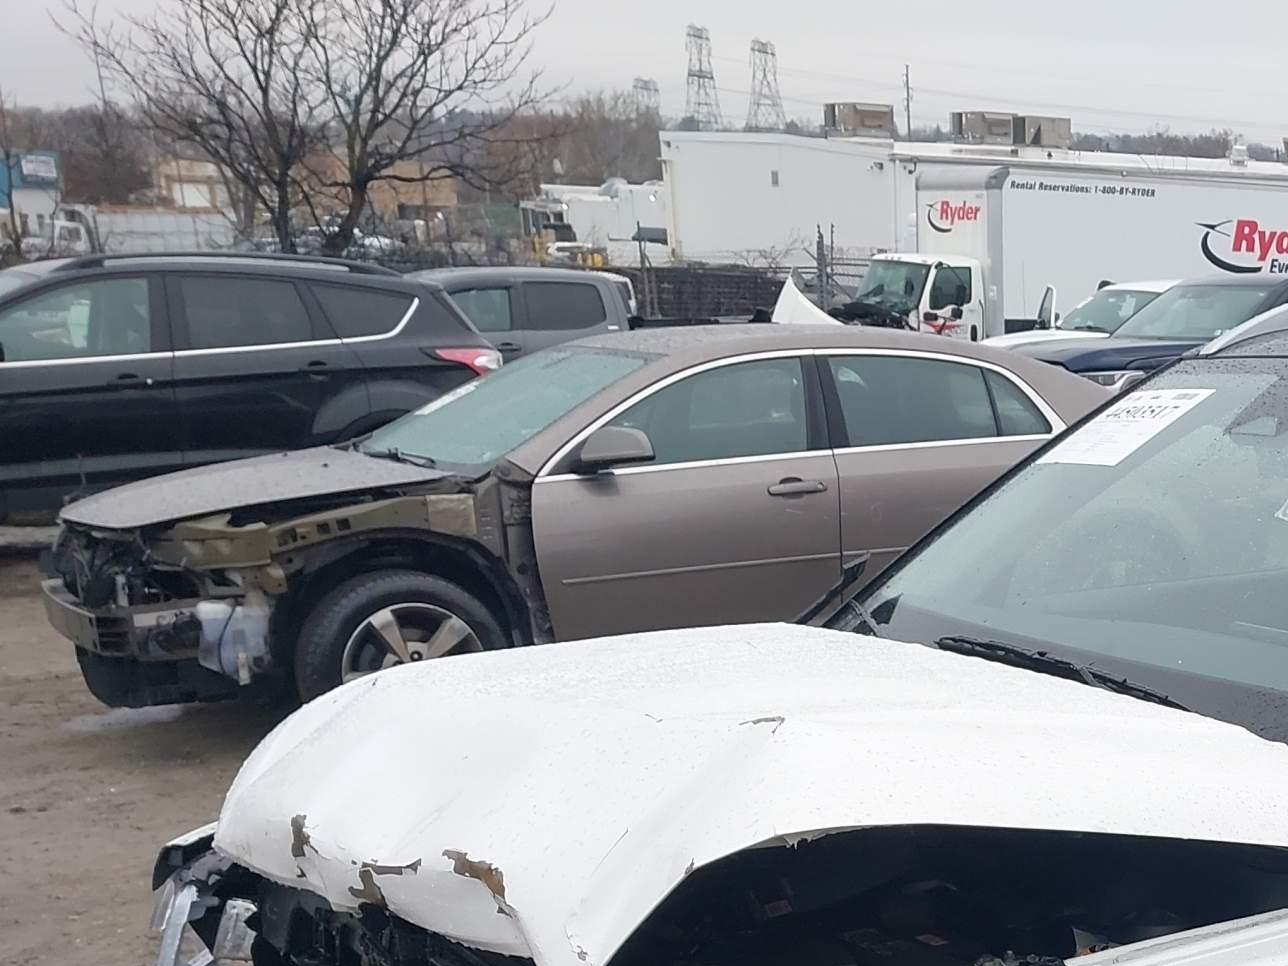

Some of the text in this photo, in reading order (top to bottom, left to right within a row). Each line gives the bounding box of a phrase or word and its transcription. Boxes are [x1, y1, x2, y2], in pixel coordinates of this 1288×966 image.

[1010, 180, 1156, 198] Rental Reservations: 1-800-BY-RYDER
[940, 200, 981, 226] Ryder
